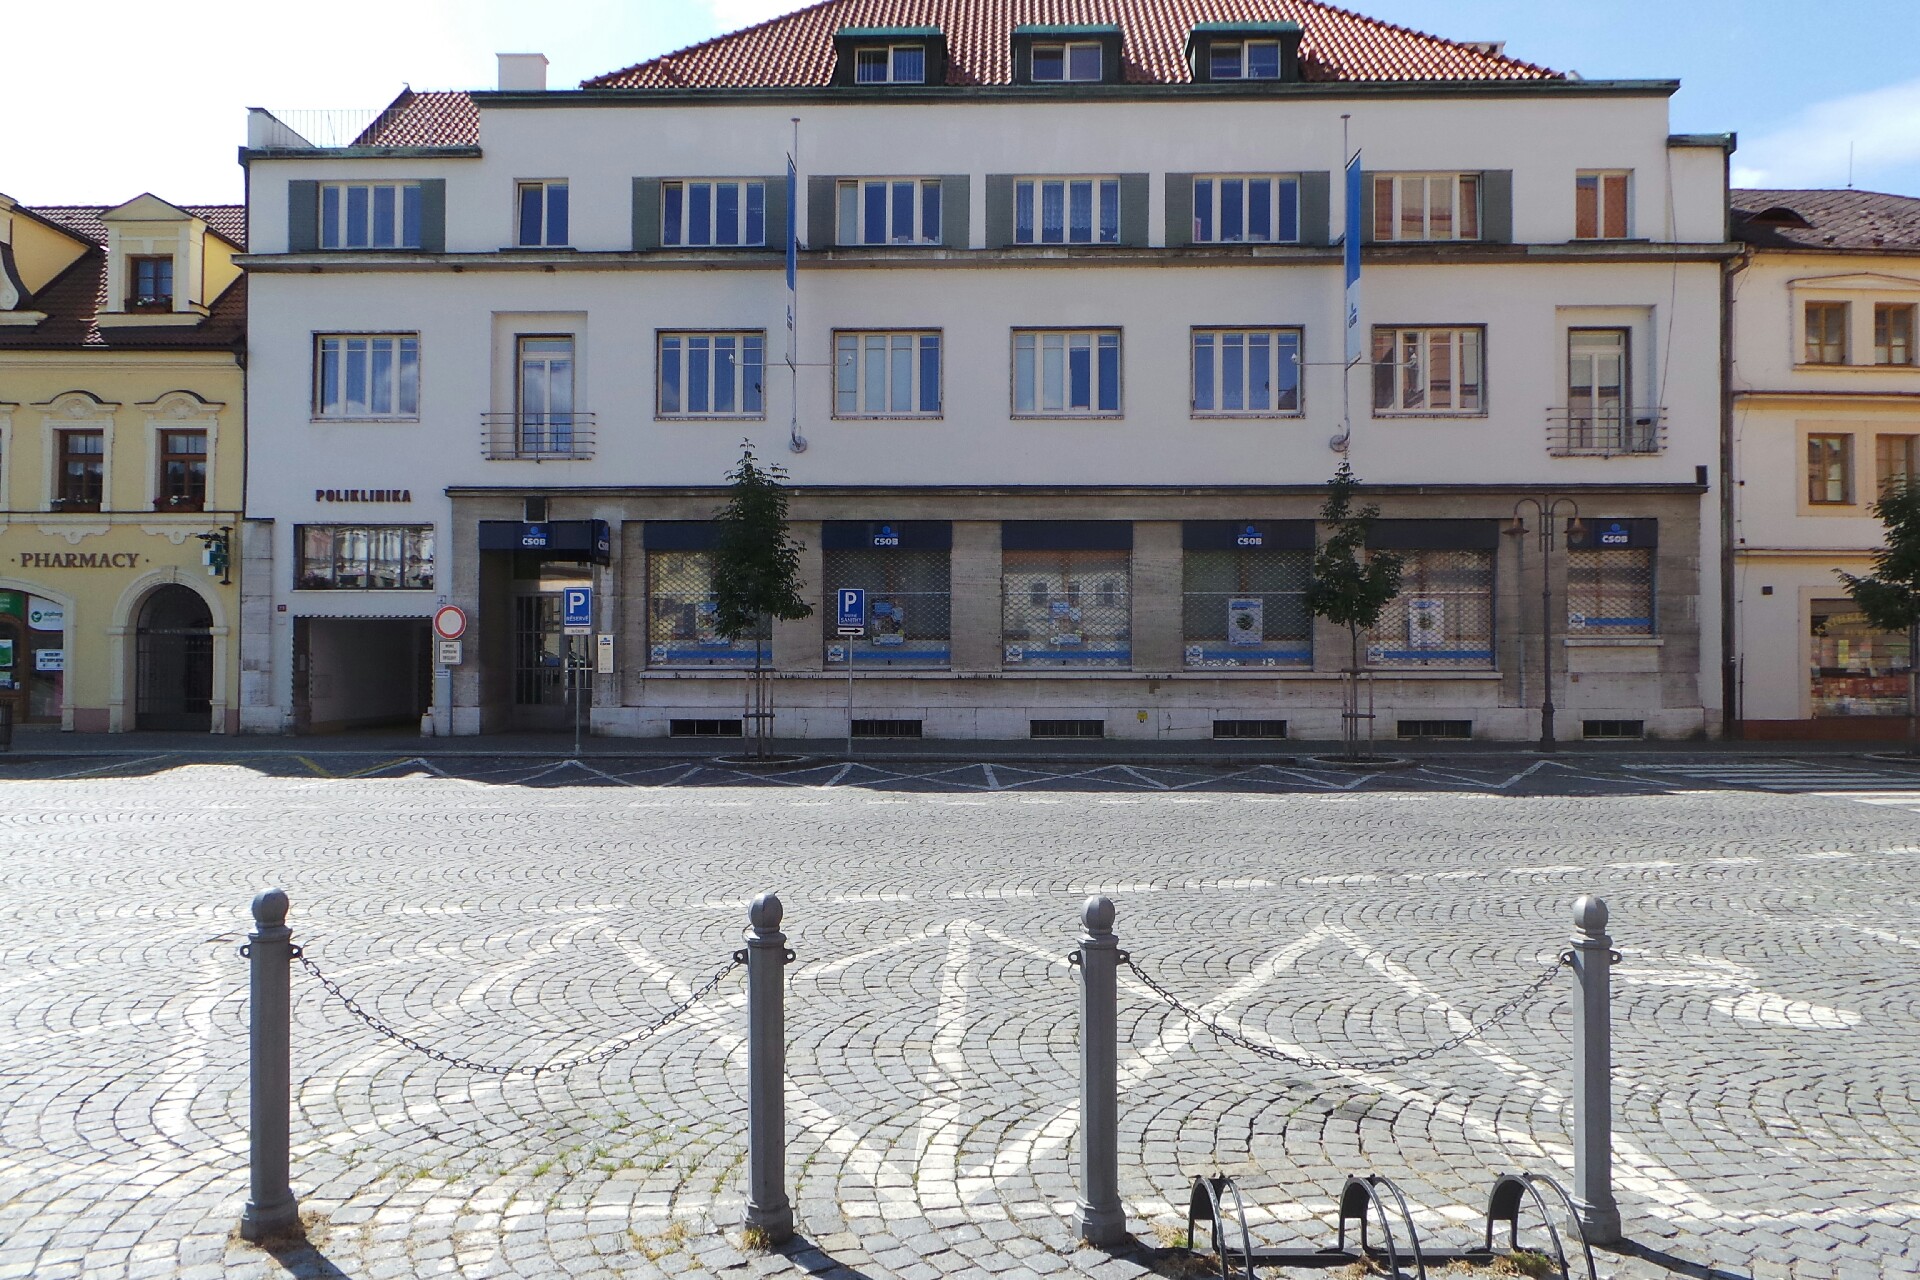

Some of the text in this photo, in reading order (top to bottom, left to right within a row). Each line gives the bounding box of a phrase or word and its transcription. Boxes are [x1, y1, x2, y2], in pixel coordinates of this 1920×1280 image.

[315, 489, 411, 502] POLIKLINIKA
[20, 552, 140, 568] PHARMACY
[569, 592, 586, 614] P
[845, 592, 857, 612] P
